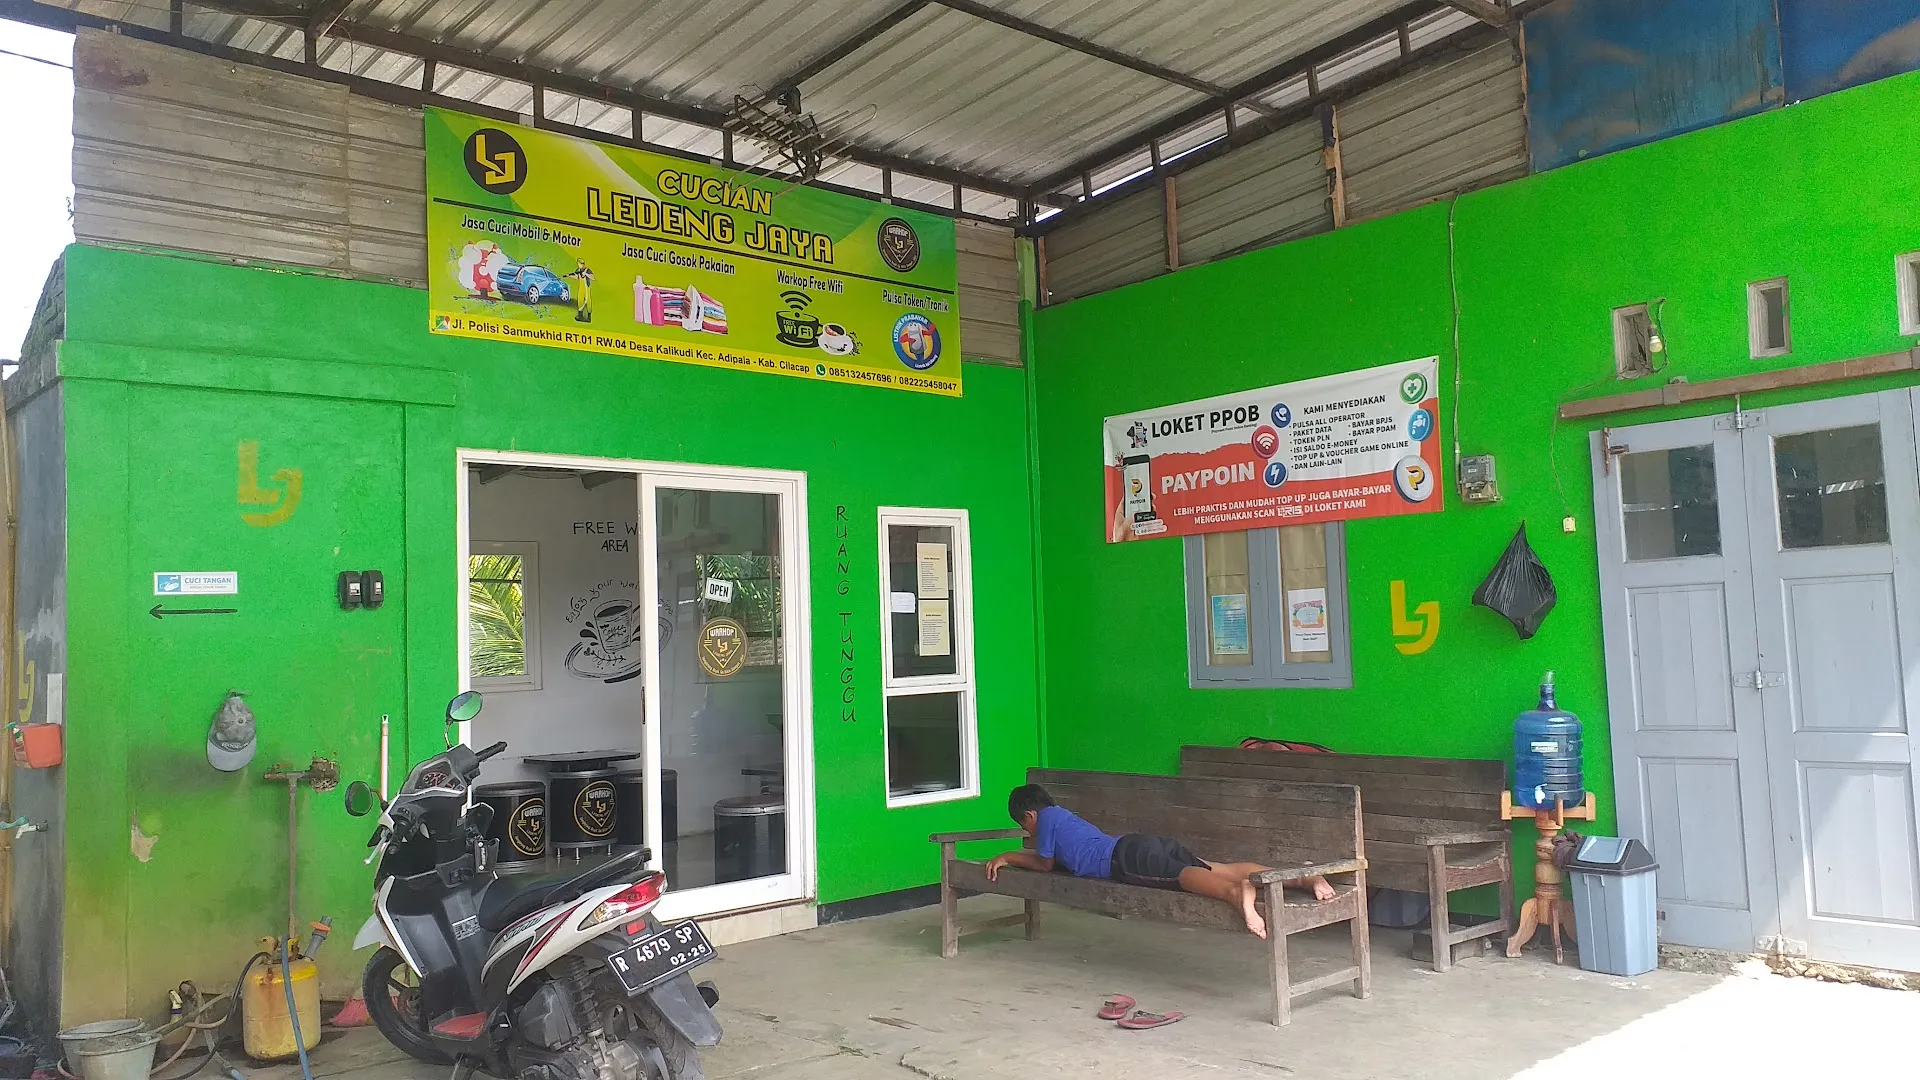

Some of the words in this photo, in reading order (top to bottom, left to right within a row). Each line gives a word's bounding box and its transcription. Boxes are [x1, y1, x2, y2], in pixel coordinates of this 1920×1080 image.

[657, 169, 773, 216] CUCIAN
[461, 214, 485, 232] Jasa
[487, 218, 510, 234] Cuci
[512, 222, 541, 241] Mobil
[542, 229, 551, 242] &
[552, 231, 582, 247] Motor
[587, 187, 735, 244] LEDENG
[745, 220, 834, 265] JAYA
[621, 243, 644, 260] Jasa
[646, 246, 667, 263] Cuci
[668, 251, 697, 269] Gosok
[699, 256, 735, 275] Pakaian
[776, 269, 808, 290] Warkop
[809, 276, 826, 291] Free
[827, 280, 844, 294] Wifi
[883, 289, 902, 304] Pulsa
[903, 292, 948, 311] Token/Tronik
[452, 318, 465, 330] Jl.
[468, 321, 499, 334] Polisi
[502, 325, 562, 342] Sanmukhid
[565, 333, 592, 345] RT.01
[596, 337, 627, 349] RW.04
[629, 341, 654, 353] Desa
[656, 344, 694, 358] Kalikudi
[696, 349, 716, 361] Kec.
[718, 352, 751, 366] Adipala
[758, 358, 777, 369] Kab.
[779, 360, 810, 374] Cilacap
[829, 367, 892, 383] 085132457696
[899, 376, 957, 391] 082225458047
[1303, 404, 1324, 415] KAMI
[1325, 395, 1386, 411] MENYEDIAKAN
[1151, 413, 1205, 439] LOKET
[1210, 404, 1260, 429] PPOB
[1292, 420, 1314, 429] PULSA
[1328, 412, 1366, 423] OPERATOR
[1352, 420, 1374, 428] BAYAR
[1376, 417, 1393, 425] BPJS
[1352, 428, 1375, 437] BAYAR
[1376, 424, 1396, 434] PDAM
[1293, 428, 1314, 437] PAKET
[1293, 437, 1316, 445] TOKEN
[1293, 446, 1303, 454] ISI
[1303, 443, 1326, 452] SALDO
[1327, 439, 1358, 449] E-MONEY
[1294, 453, 1308, 462] TOP
[1325, 446, 1359, 457] VOUCHER
[1360, 443, 1380, 453] GAME
[1381, 440, 1409, 450] ONLINE
[1294, 462, 1308, 470] DAN
[1309, 458, 1343, 468] LAIN-LAIN
[1161, 461, 1255, 495] PAYPOIN
[1173, 507, 1195, 516] LEBIH
[1196, 503, 1228, 514] PRAKTIS
[1229, 501, 1245, 509] DAN
[1246, 497, 1275, 508] MUDAH
[1276, 495, 1293, 504] TOP
[1295, 494, 1306, 503] UP
[1308, 490, 1331, 501] JUGA
[1332, 484, 1392, 500] BAYAR-BAYAR
[1194, 511, 1253, 524] MENGGUNAKAN
[1253, 508, 1275, 518] SCAN
[1304, 504, 1313, 514] DI
[1315, 502, 1342, 512] LOKET
[1344, 499, 1366, 509] KAMI
[573, 521, 615, 535] FREE
[601, 539, 629, 553] AREA
[835, 505, 851, 596] RUANG
[709, 583, 729, 597] OPEN
[838, 612, 857, 723] TUNGGU
[615, 956, 630, 973] R
[636, 937, 672, 963] 4679
[675, 926, 693, 944] SP
